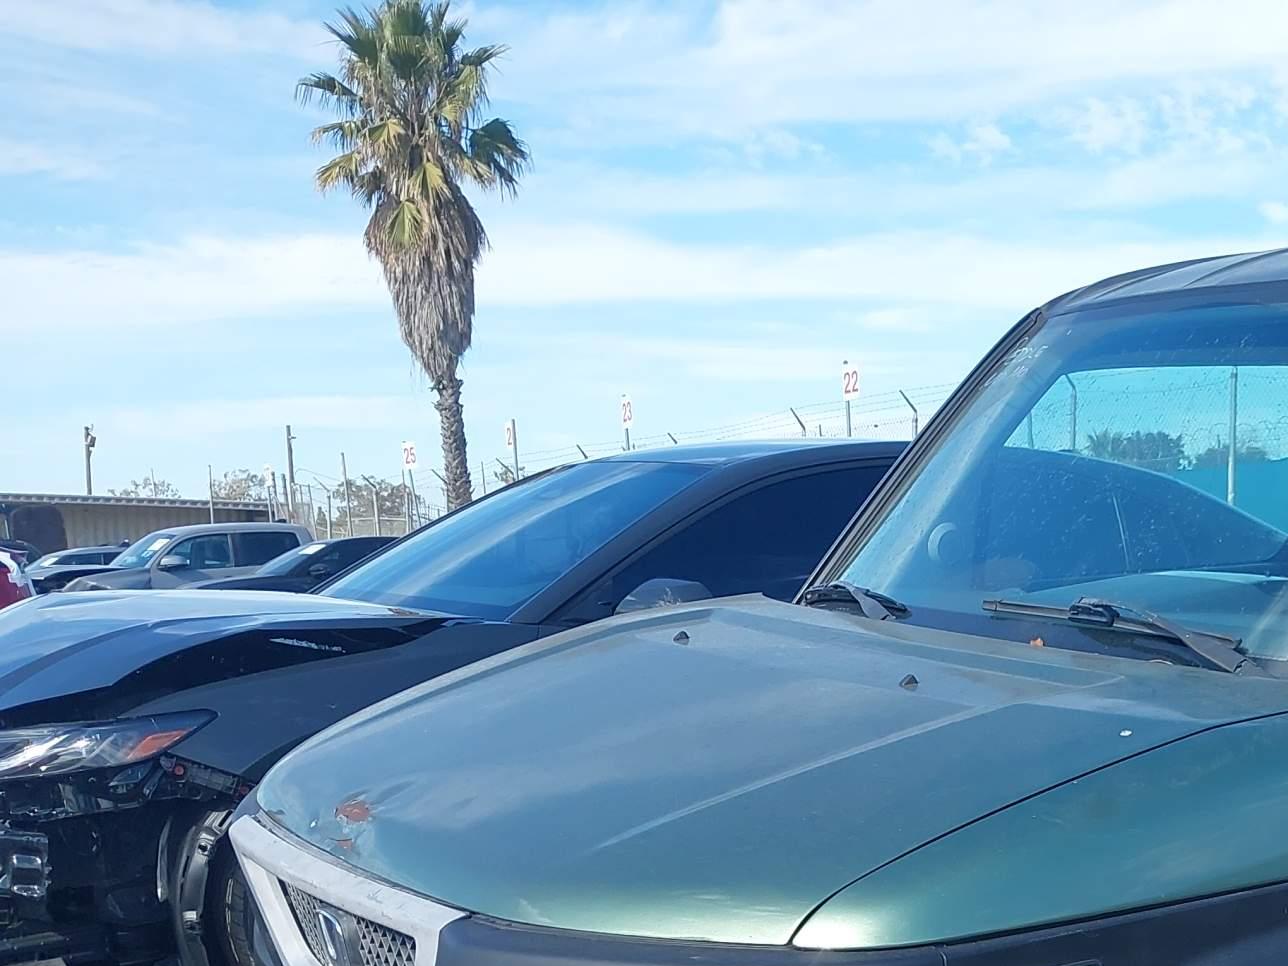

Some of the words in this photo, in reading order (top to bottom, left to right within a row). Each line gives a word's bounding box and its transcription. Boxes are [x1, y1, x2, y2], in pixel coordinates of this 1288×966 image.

[843, 370, 859, 394] 22
[622, 401, 633, 423] 23
[403, 447, 417, 464] 25
